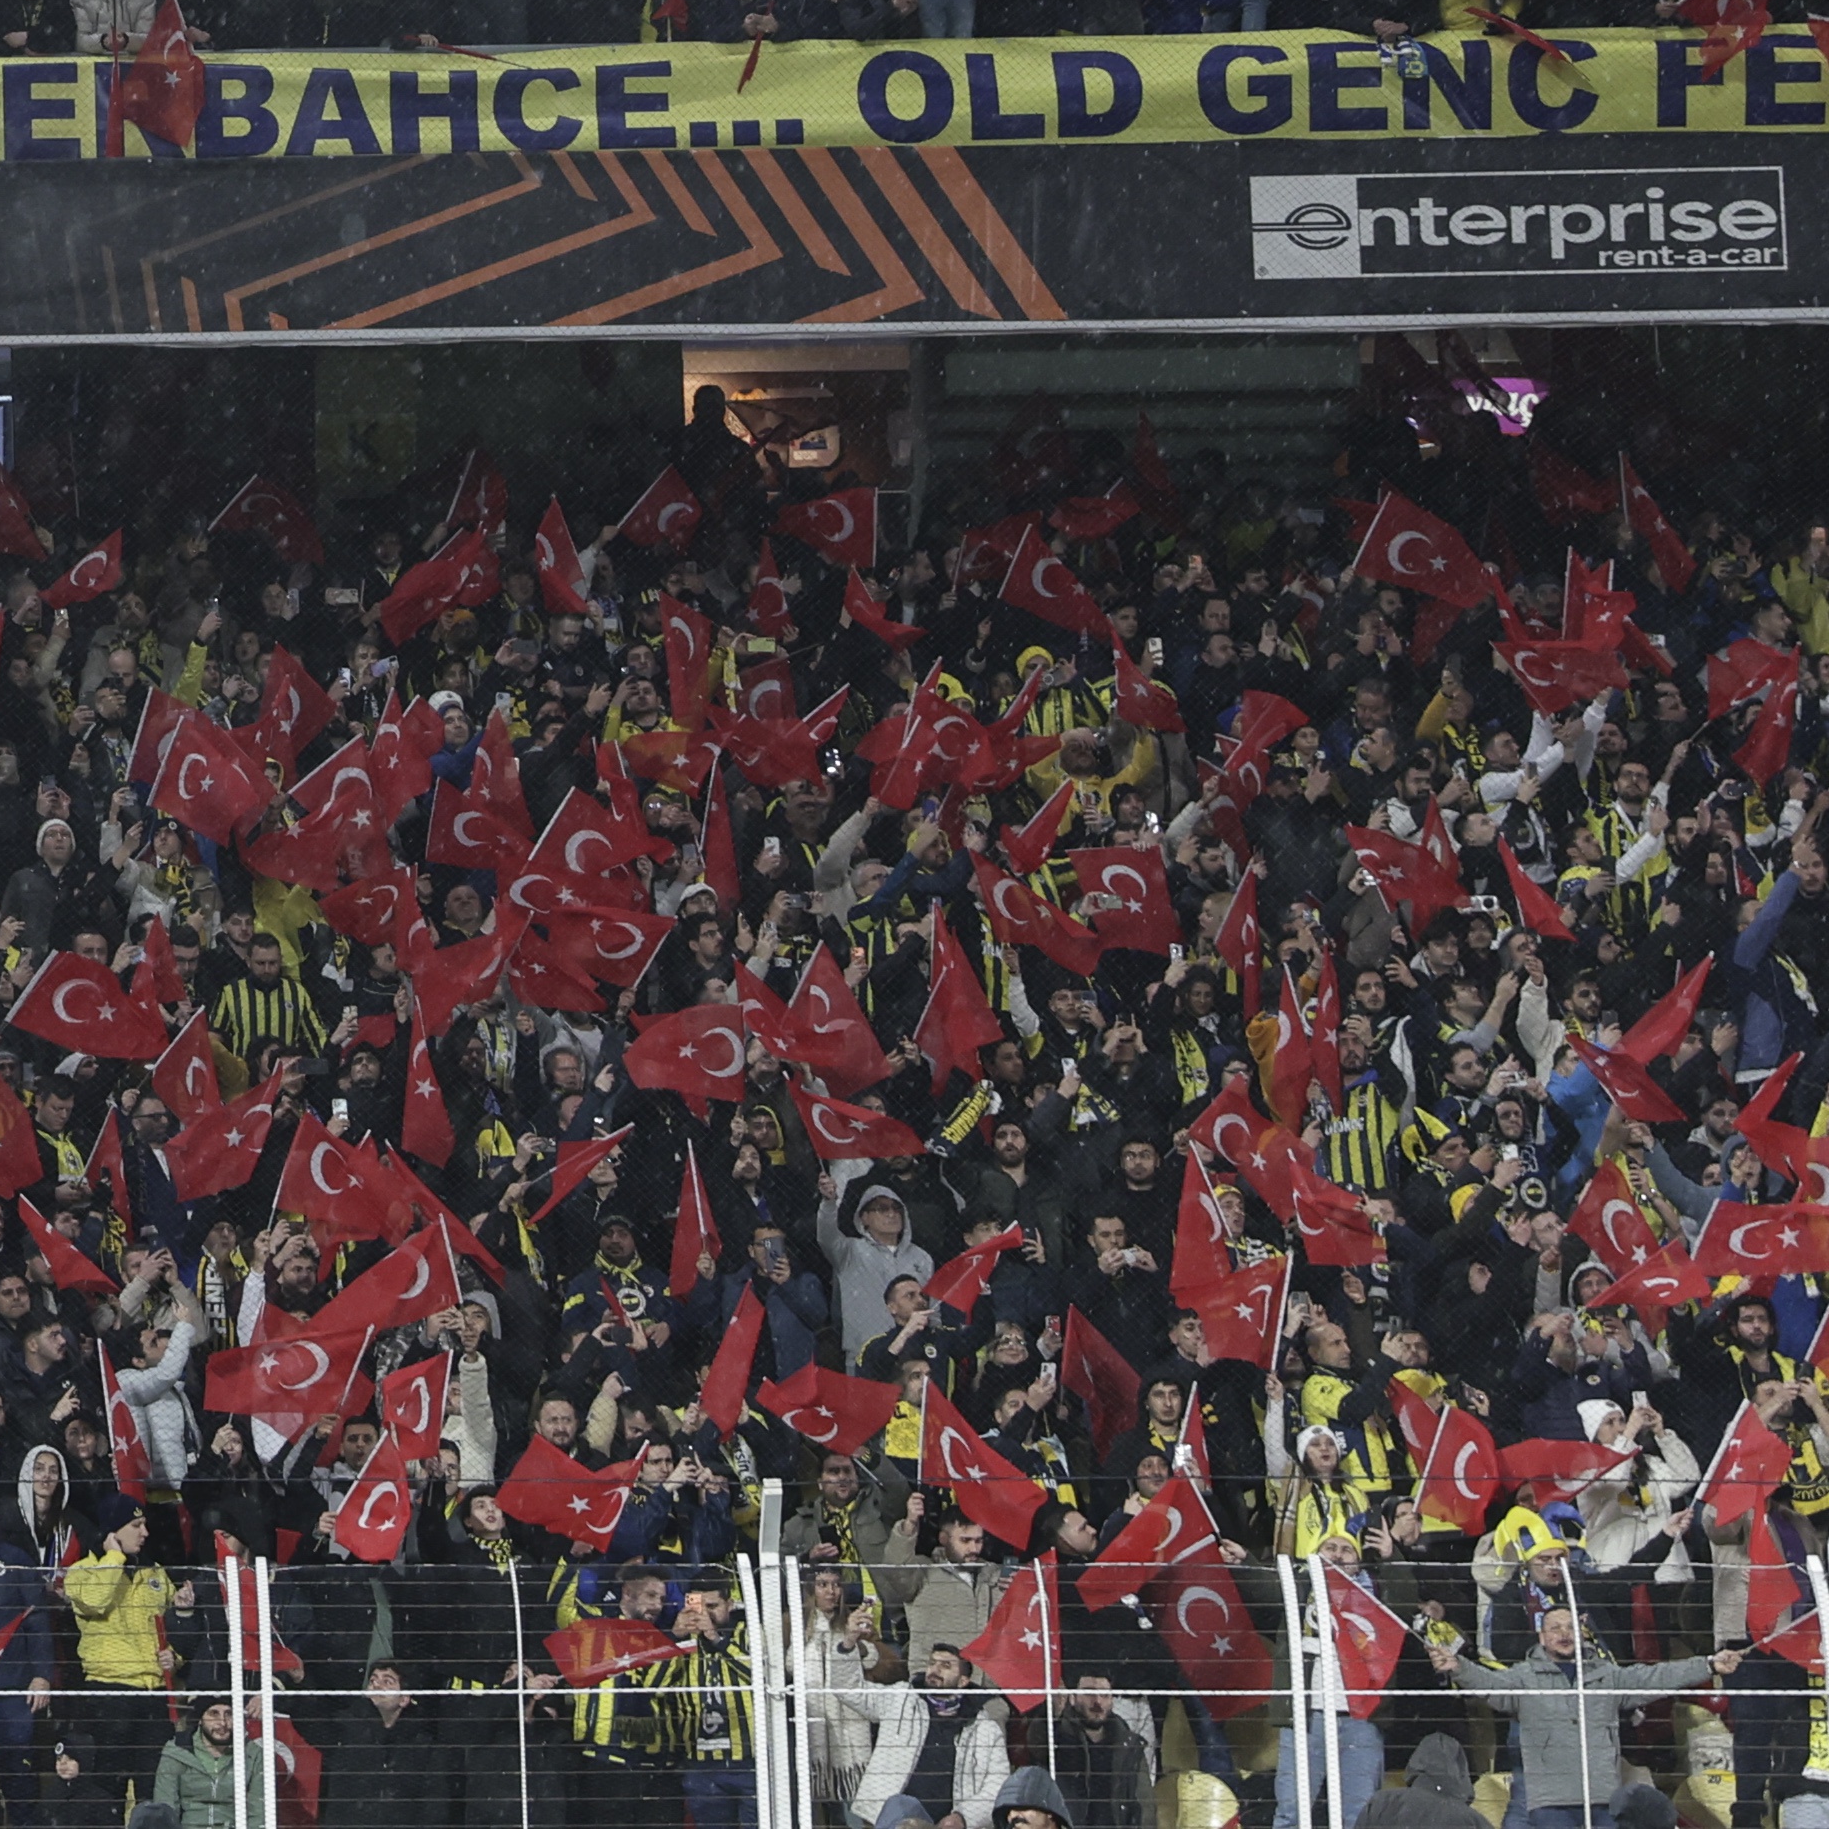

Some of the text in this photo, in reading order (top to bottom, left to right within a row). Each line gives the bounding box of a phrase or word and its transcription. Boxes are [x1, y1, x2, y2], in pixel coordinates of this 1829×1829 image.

[857, 45, 1145, 143] OLD
[1267, 186, 1779, 259] enterprise
[1598, 244, 1779, 267] rent-a-car
